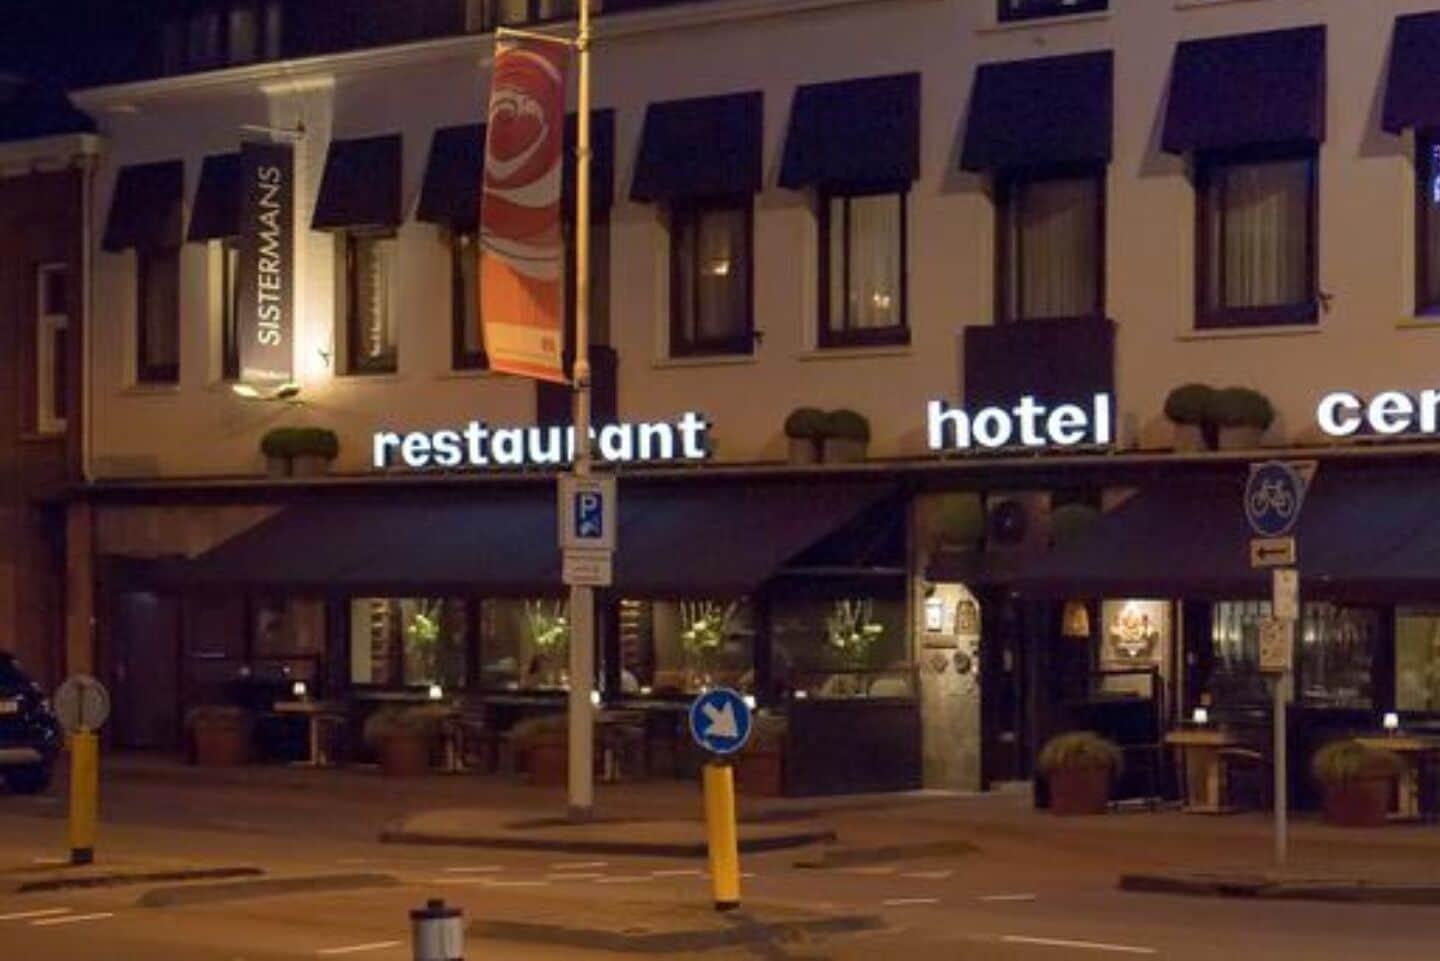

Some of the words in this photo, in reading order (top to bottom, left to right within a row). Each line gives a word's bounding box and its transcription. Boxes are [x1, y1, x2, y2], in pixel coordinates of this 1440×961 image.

[258, 166, 281, 346] SISTERMANS
[927, 392, 1110, 450] hotel
[581, 495, 598, 519] P
